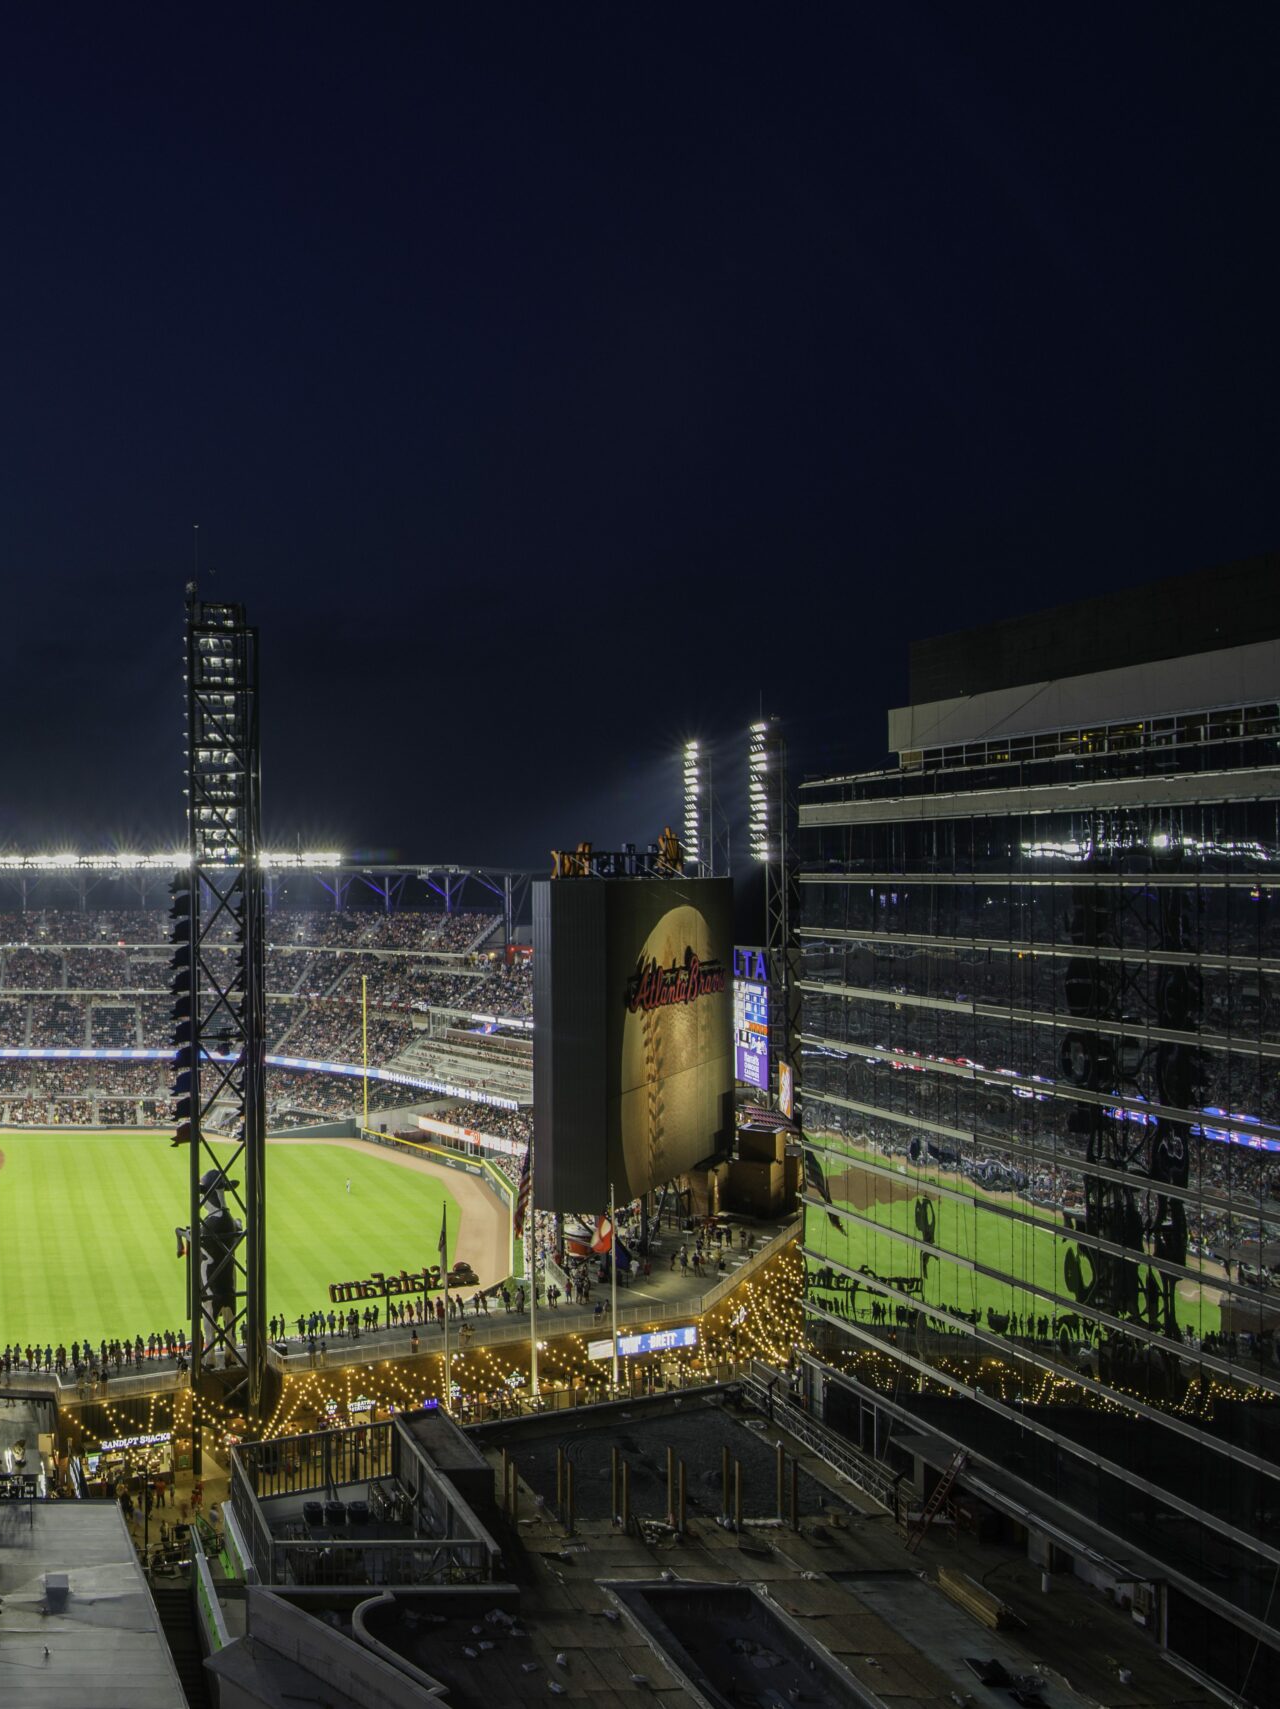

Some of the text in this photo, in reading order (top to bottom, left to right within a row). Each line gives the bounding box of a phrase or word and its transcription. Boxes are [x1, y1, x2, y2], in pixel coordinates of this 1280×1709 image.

[631, 963, 687, 1012] Atlanta
[101, 1432, 171, 1449] SANDLOT SNACKS
